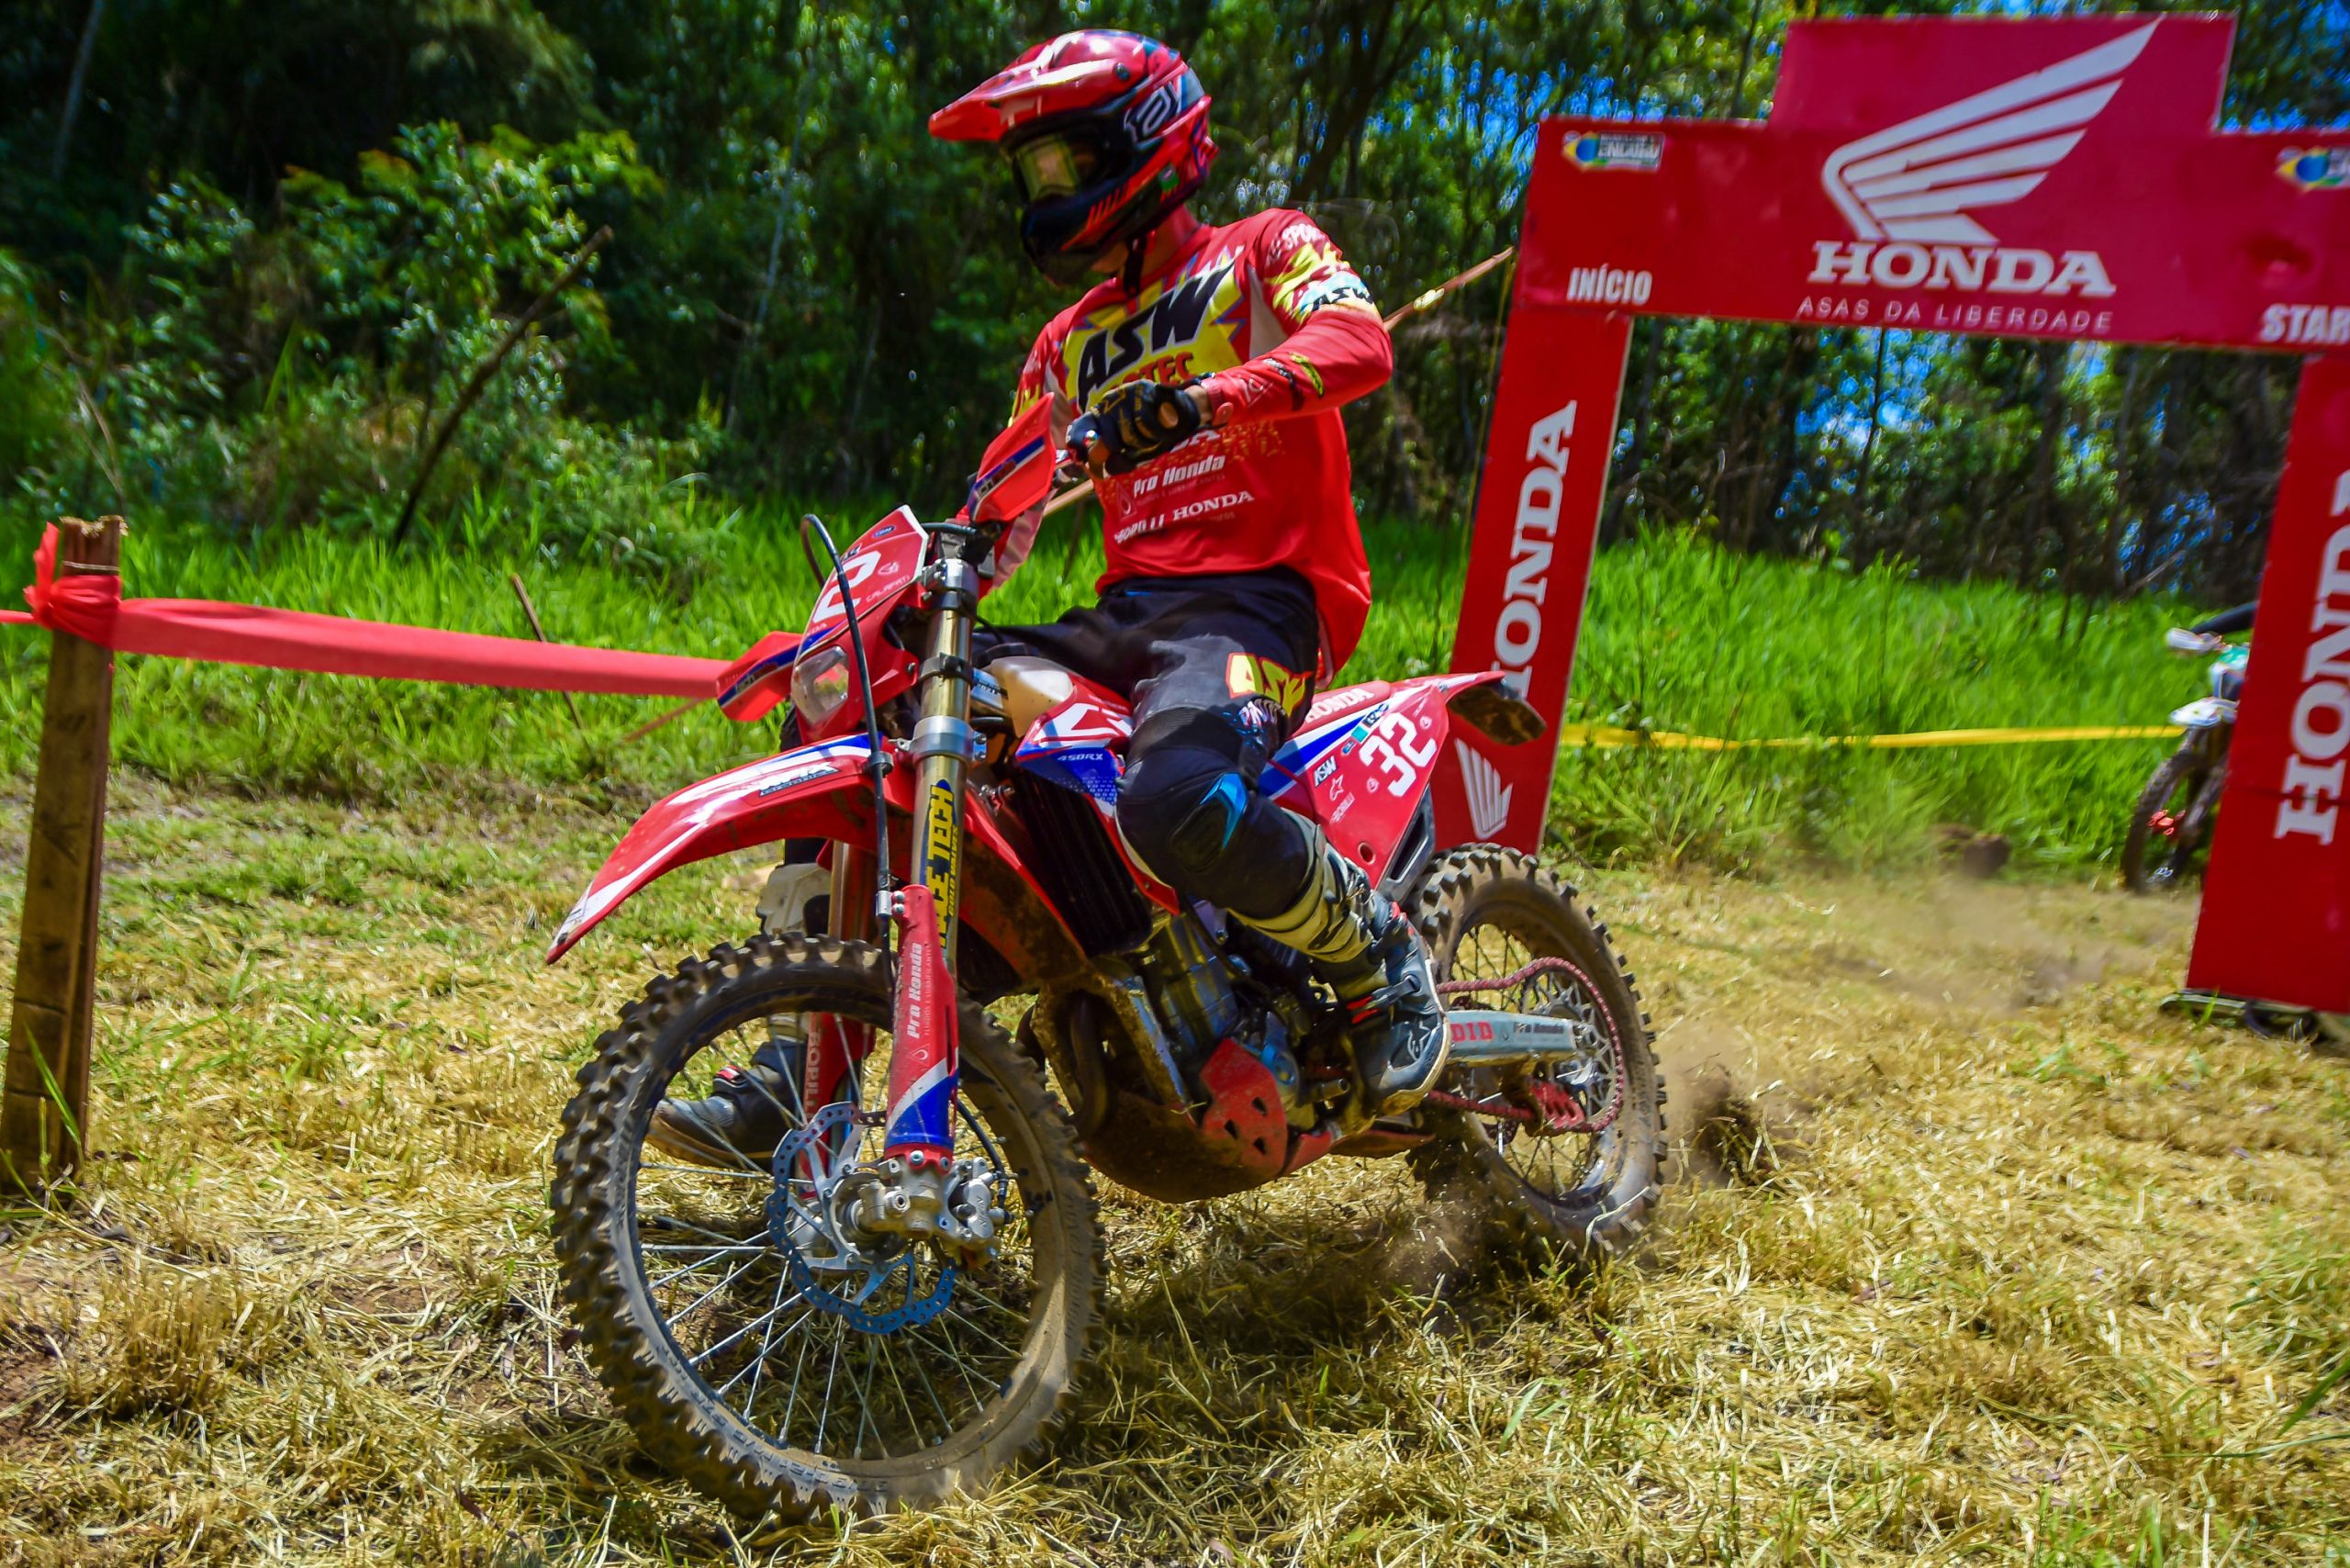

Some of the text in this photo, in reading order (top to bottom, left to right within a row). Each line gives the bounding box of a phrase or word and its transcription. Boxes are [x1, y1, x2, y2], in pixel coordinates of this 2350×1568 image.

[1566, 263, 1652, 306] INÍCIO
[1807, 241, 2117, 297] HONDA
[1077, 260, 1236, 415] ASW
[1795, 296, 2114, 335] ASAS DA LIBERDADE
[1133, 475, 1158, 498] Pro
[1162, 455, 1226, 487] Honda
[1173, 490, 1256, 521] HONDA
[1225, 653, 1313, 717] ASW
[1313, 755, 1338, 788] ASW
[1359, 711, 1438, 797] 32
[927, 785, 955, 863] TECH
[907, 942, 923, 1039] Pro Honda
[1450, 1021, 1494, 1043] DID
